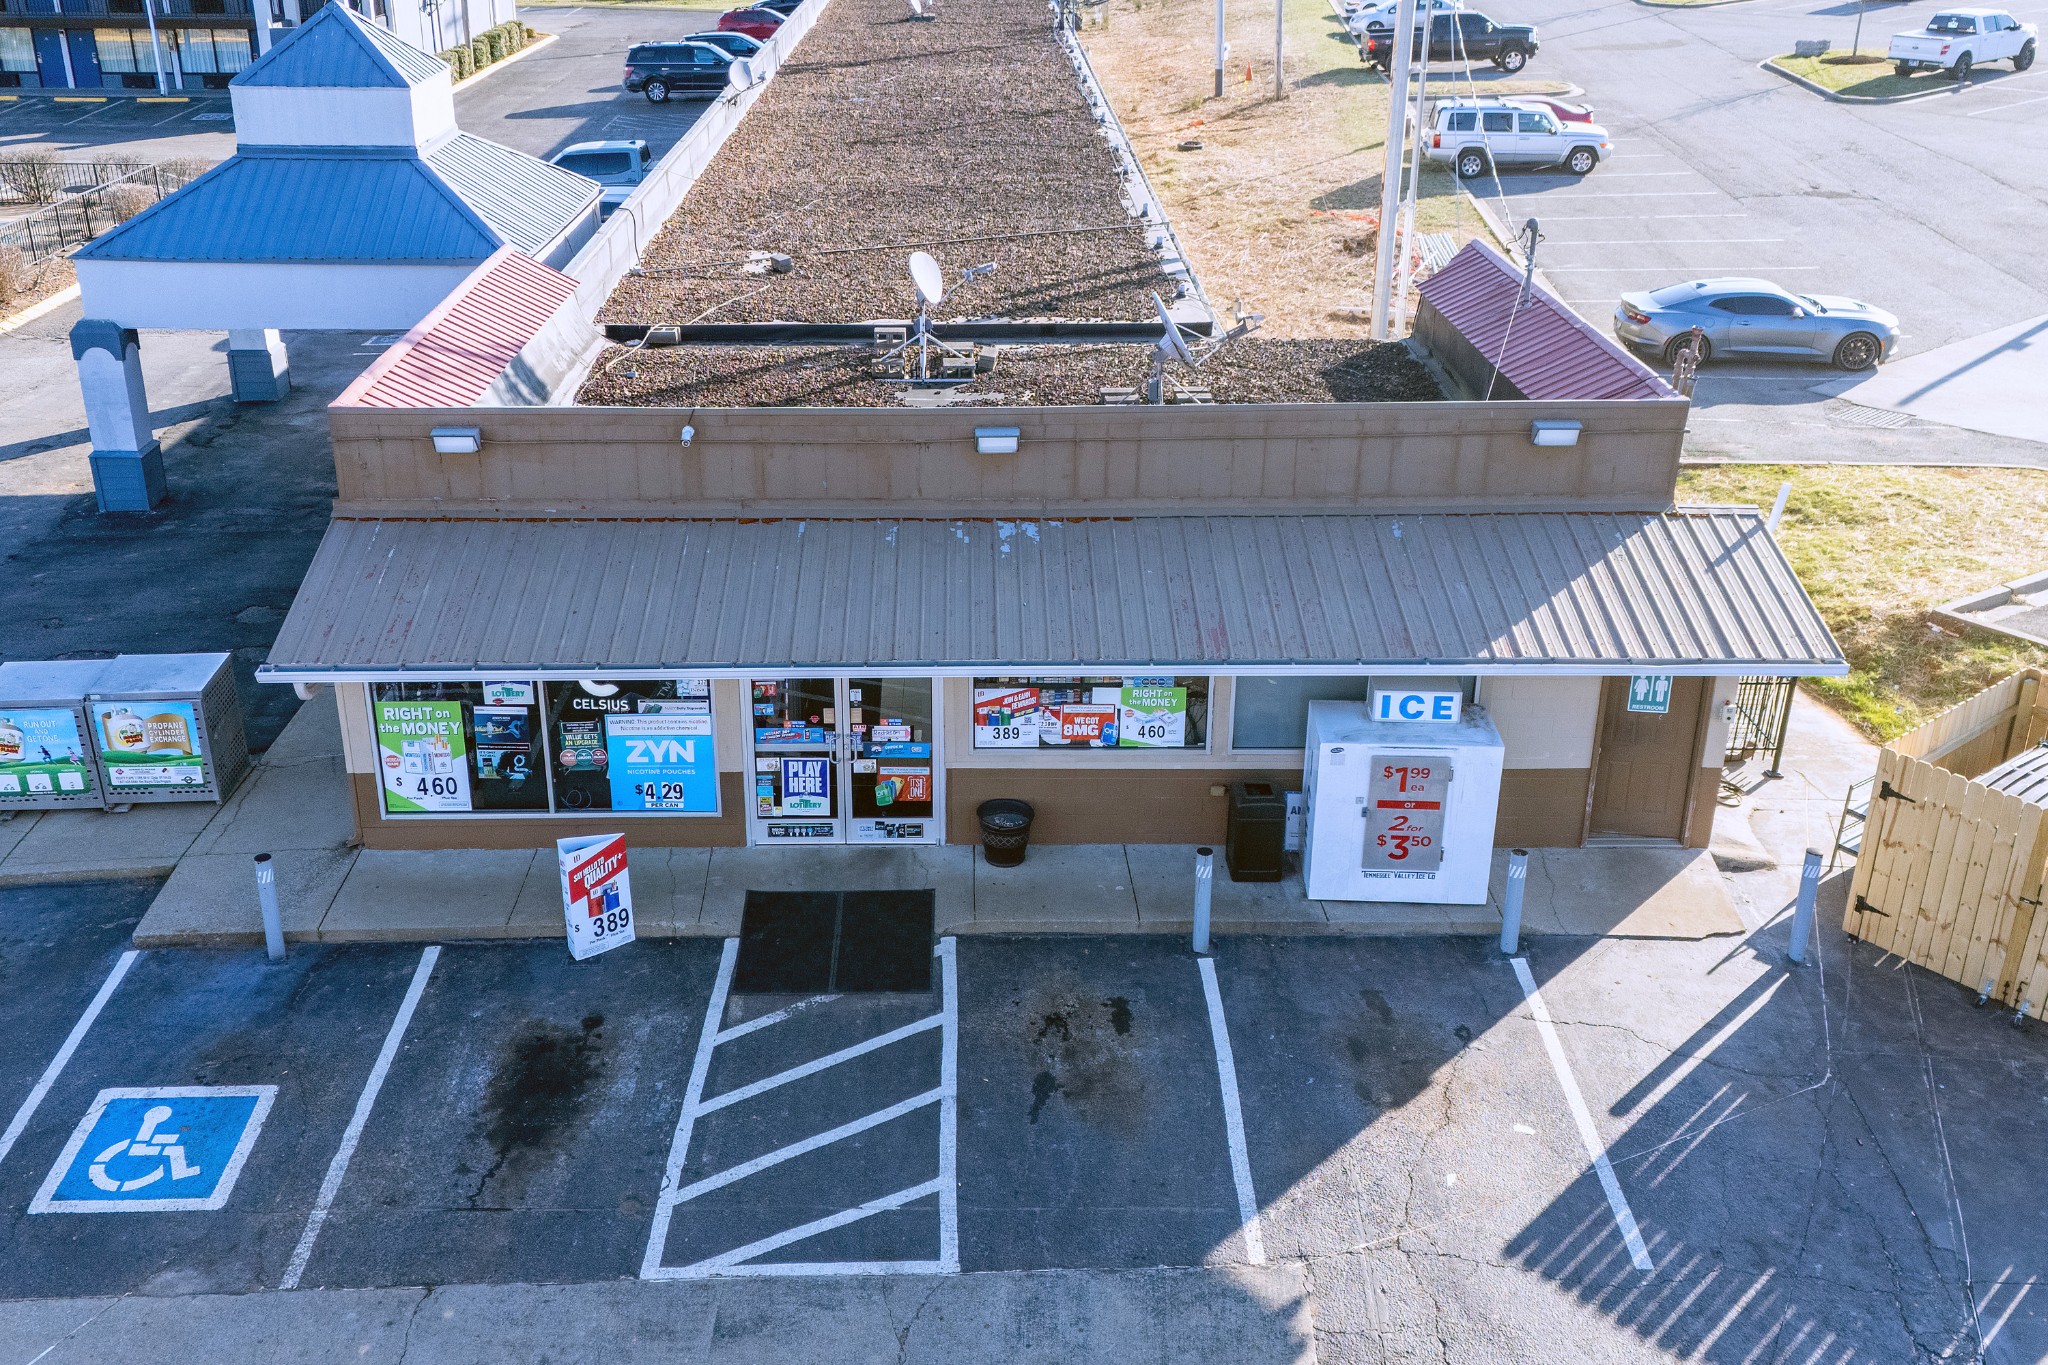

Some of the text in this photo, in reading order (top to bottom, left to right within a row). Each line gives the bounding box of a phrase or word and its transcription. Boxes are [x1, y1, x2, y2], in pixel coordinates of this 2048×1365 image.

[1132, 689, 1163, 698] RIGHT
[572, 699, 629, 710] CELSIUS
[1142, 698, 1178, 707] MONEY
[1381, 694, 1454, 720] ICE
[383, 707, 451, 721] RIGHT on
[23, 720, 56, 729] RUN OUT
[147, 721, 184, 730] PROPANE
[1074, 716, 1100, 725] WE GOT
[379, 723, 400, 733] the
[401, 721, 461, 736] MONEY
[1063, 724, 1099, 736] 8MG
[27, 735, 41, 743] GET
[150, 735, 186, 743] EXCHANGE
[625, 739, 695, 763] ZYN
[788, 761, 822, 777] PLAY
[788, 777, 822, 793] HERE
[1410, 784, 1425, 792] ea
[789, 799, 822, 809] LOTTERY
[1388, 815, 1424, 832] 2 for
[1362, 870, 1391, 879] TENNESSEE
[1393, 870, 1415, 879] VALLEY
[1415, 871, 1426, 880] ICE
